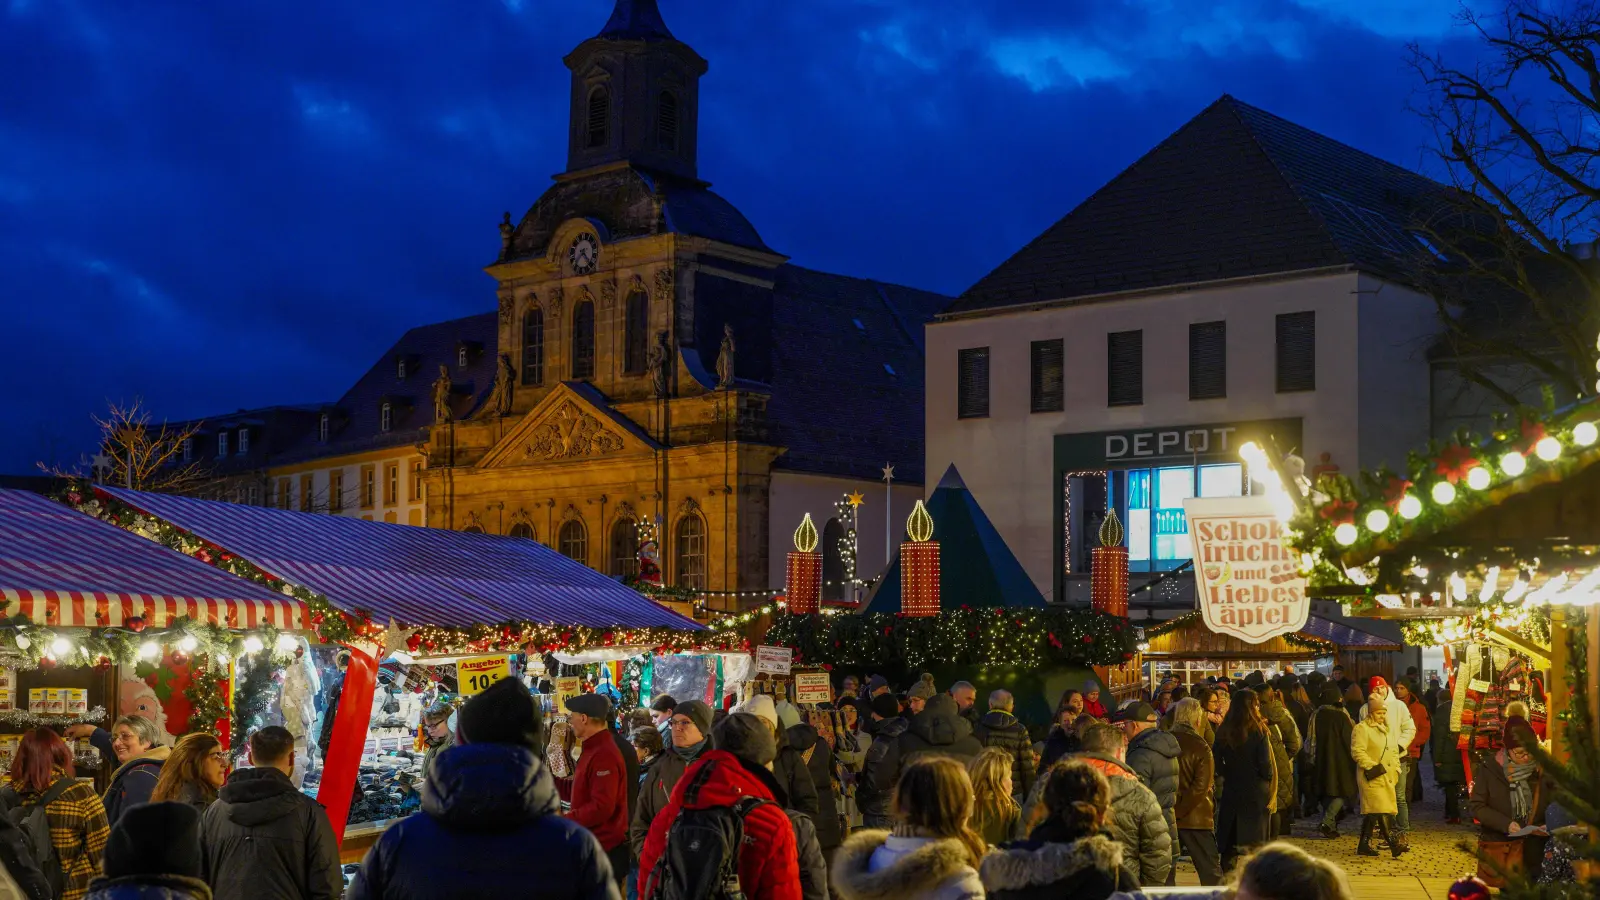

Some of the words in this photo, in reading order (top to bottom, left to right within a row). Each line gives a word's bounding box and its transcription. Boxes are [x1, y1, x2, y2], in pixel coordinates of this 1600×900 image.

[1105, 427, 1236, 458] DEPOT
[1233, 568, 1267, 580] und
[1220, 605, 1290, 628] äpfel
[460, 658, 506, 669] Angebot
